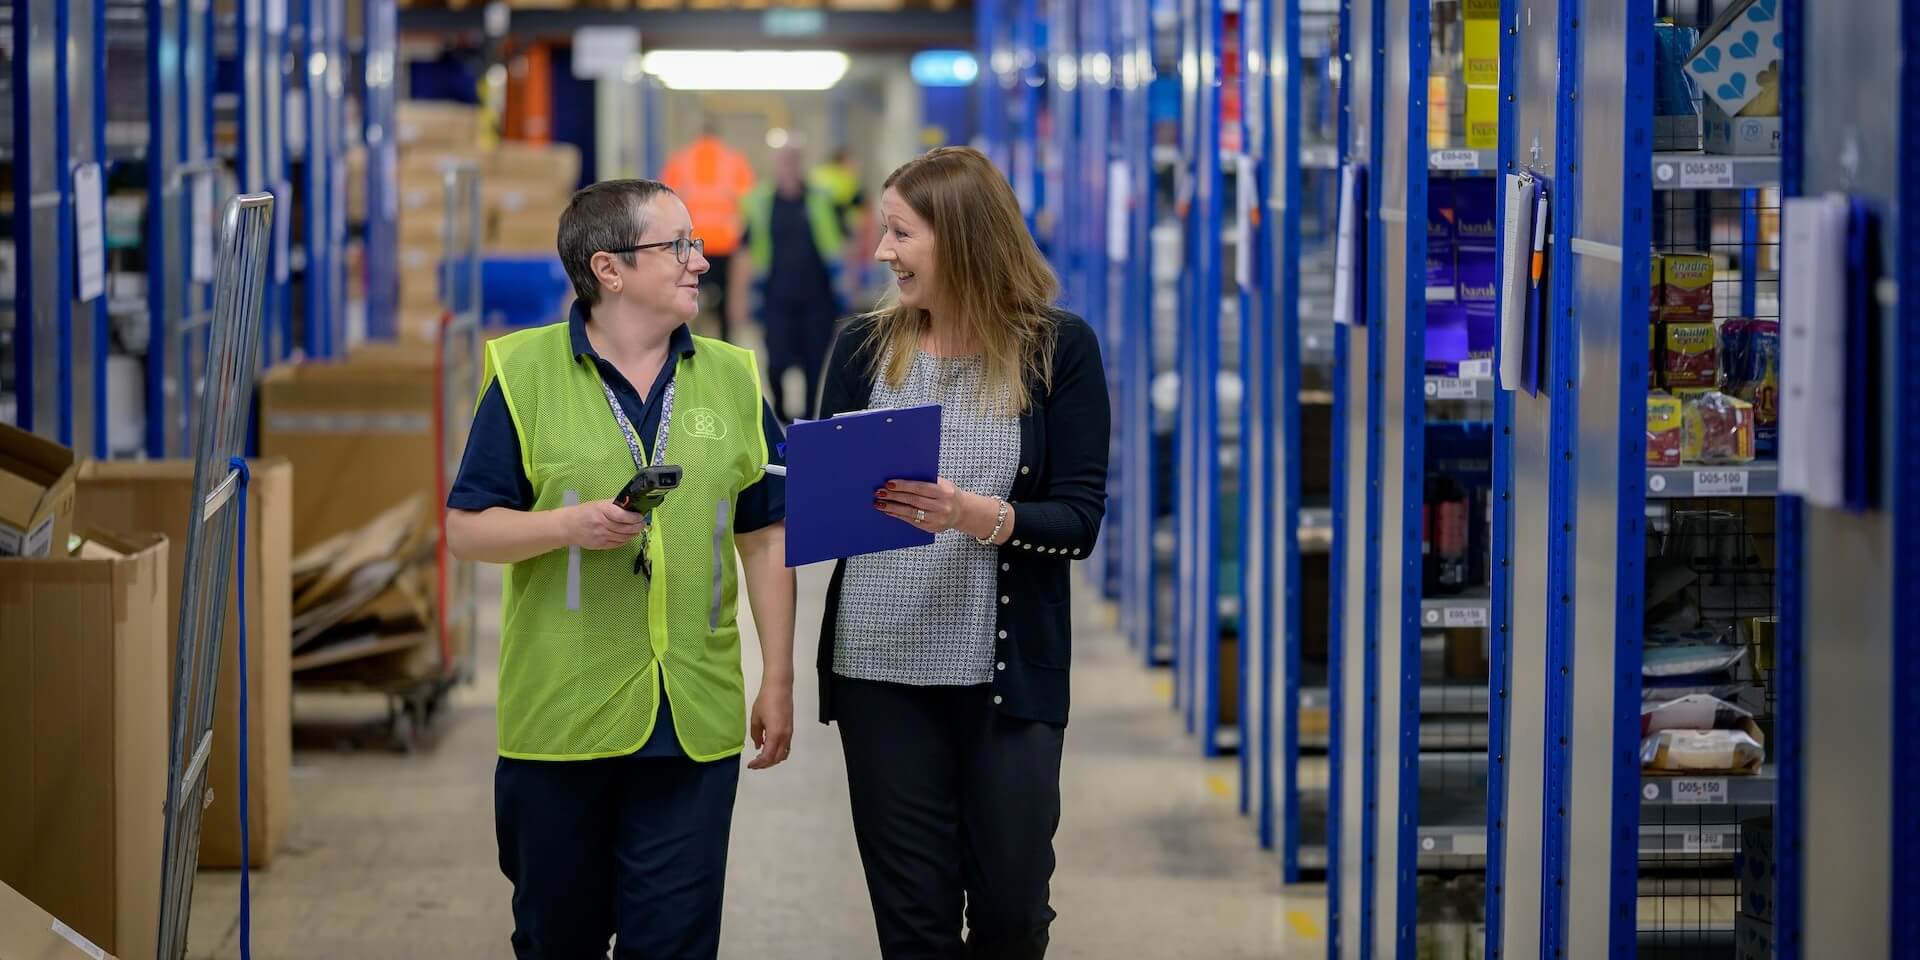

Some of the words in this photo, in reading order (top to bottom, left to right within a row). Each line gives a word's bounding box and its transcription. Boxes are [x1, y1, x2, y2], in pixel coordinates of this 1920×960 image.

[1685, 163, 1727, 175] D05-050
[1699, 473, 1741, 484] D05-100
[1678, 781, 1720, 793] D05-150
